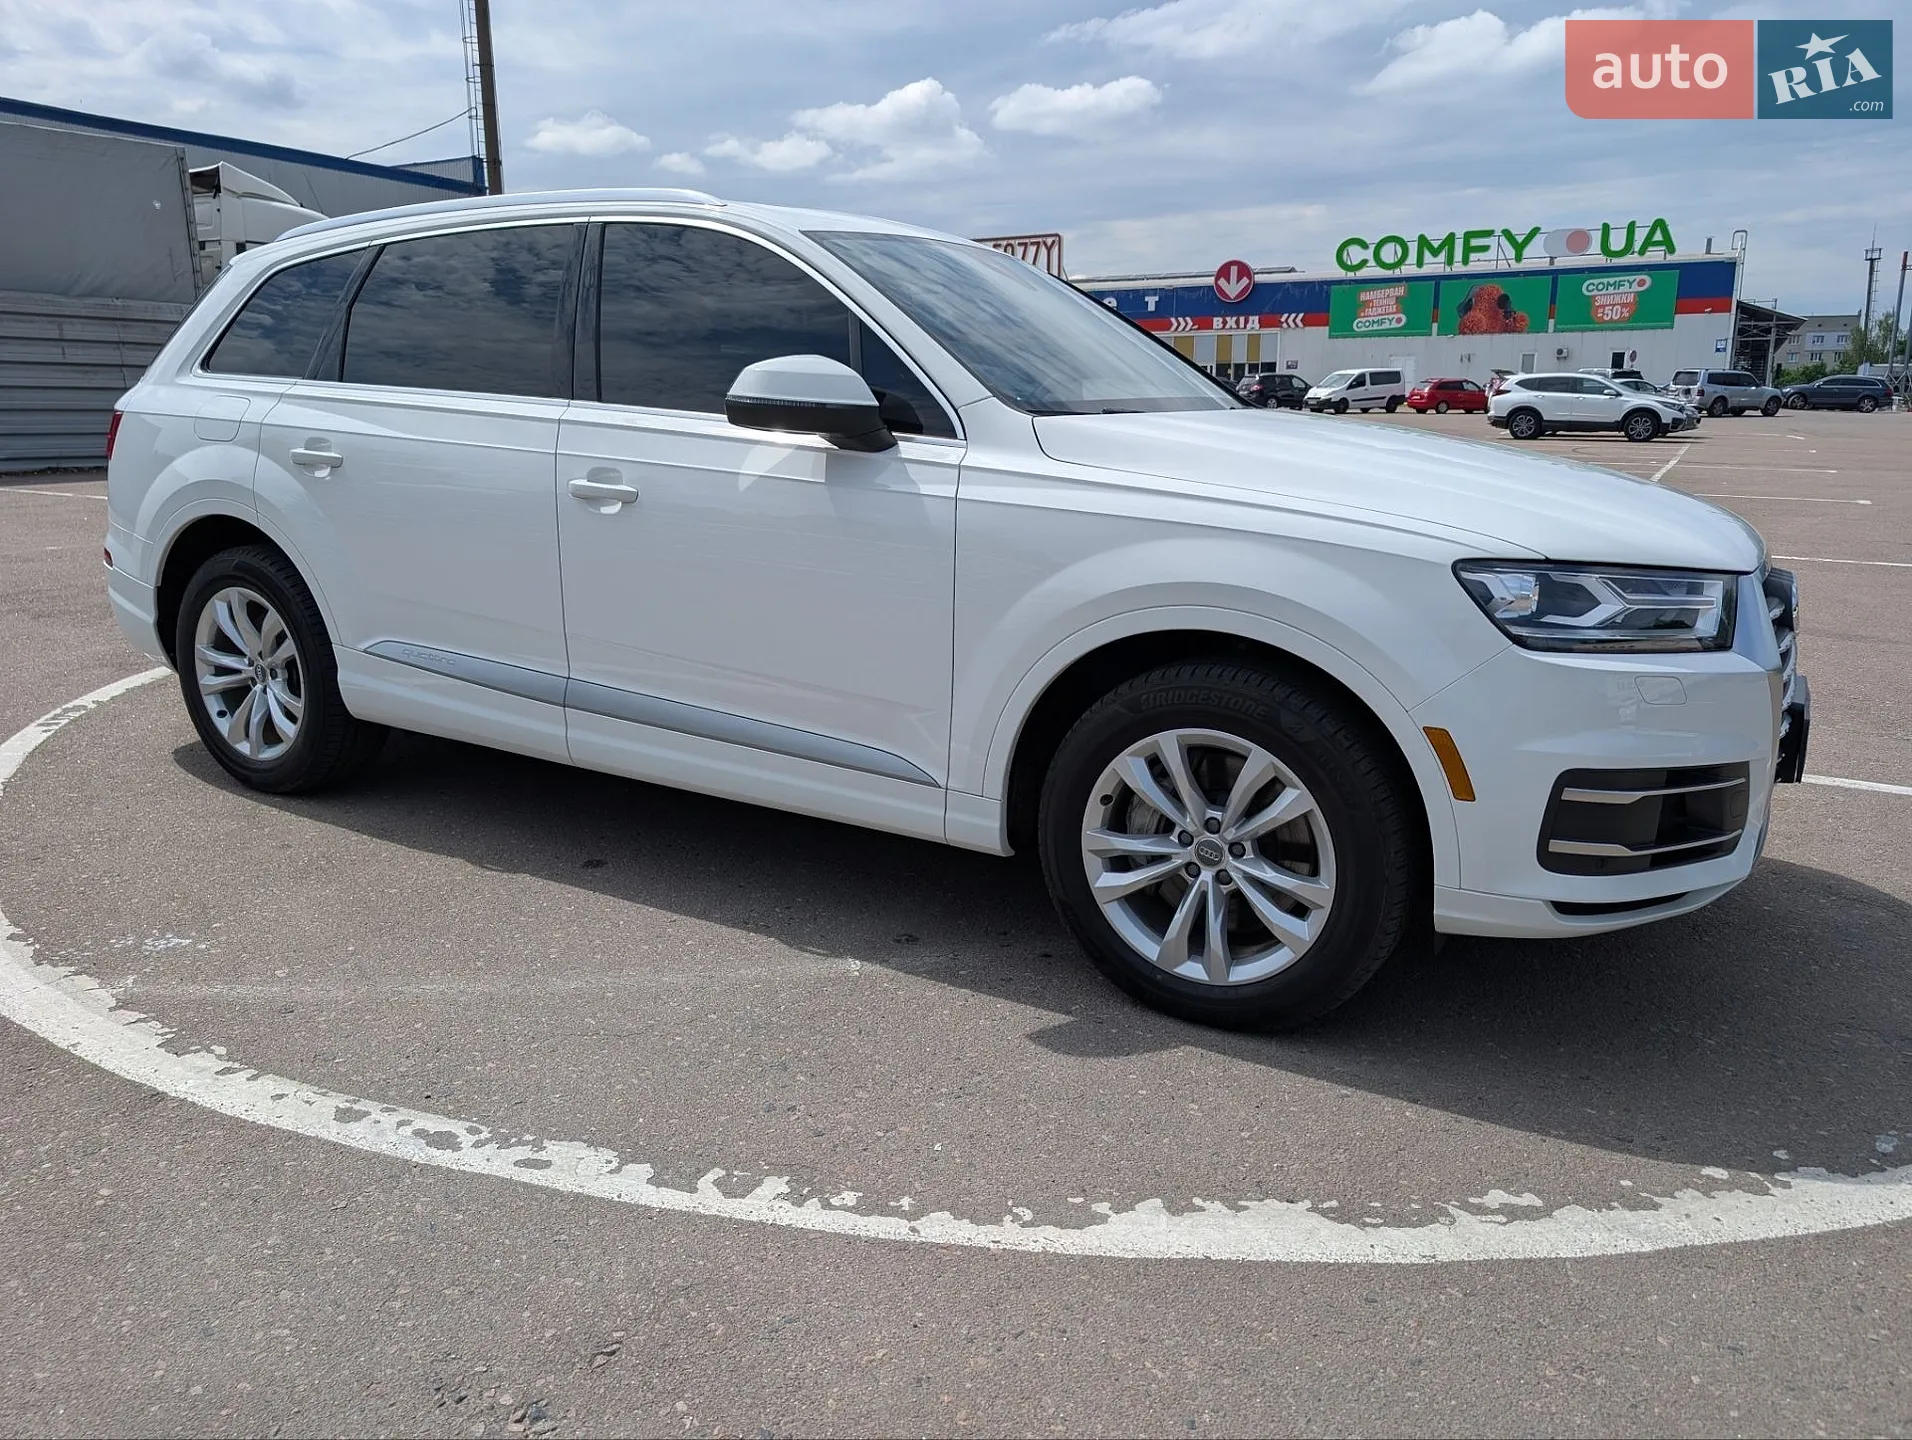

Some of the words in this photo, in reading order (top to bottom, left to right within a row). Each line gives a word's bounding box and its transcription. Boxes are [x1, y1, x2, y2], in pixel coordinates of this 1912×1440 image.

[1335, 226, 1541, 273] COMFY
[1600, 217, 1677, 259] UA
[1585, 278, 1637, 293] COMFY
[1360, 286, 1405, 301] НАМБЕРВАН
[1594, 292, 1635, 306] ЗНИЖКИ
[1212, 315, 1260, 330] ВХІД
[1355, 316, 1396, 329] COMFY
[1140, 688, 1268, 720] BRIDGESTONE
